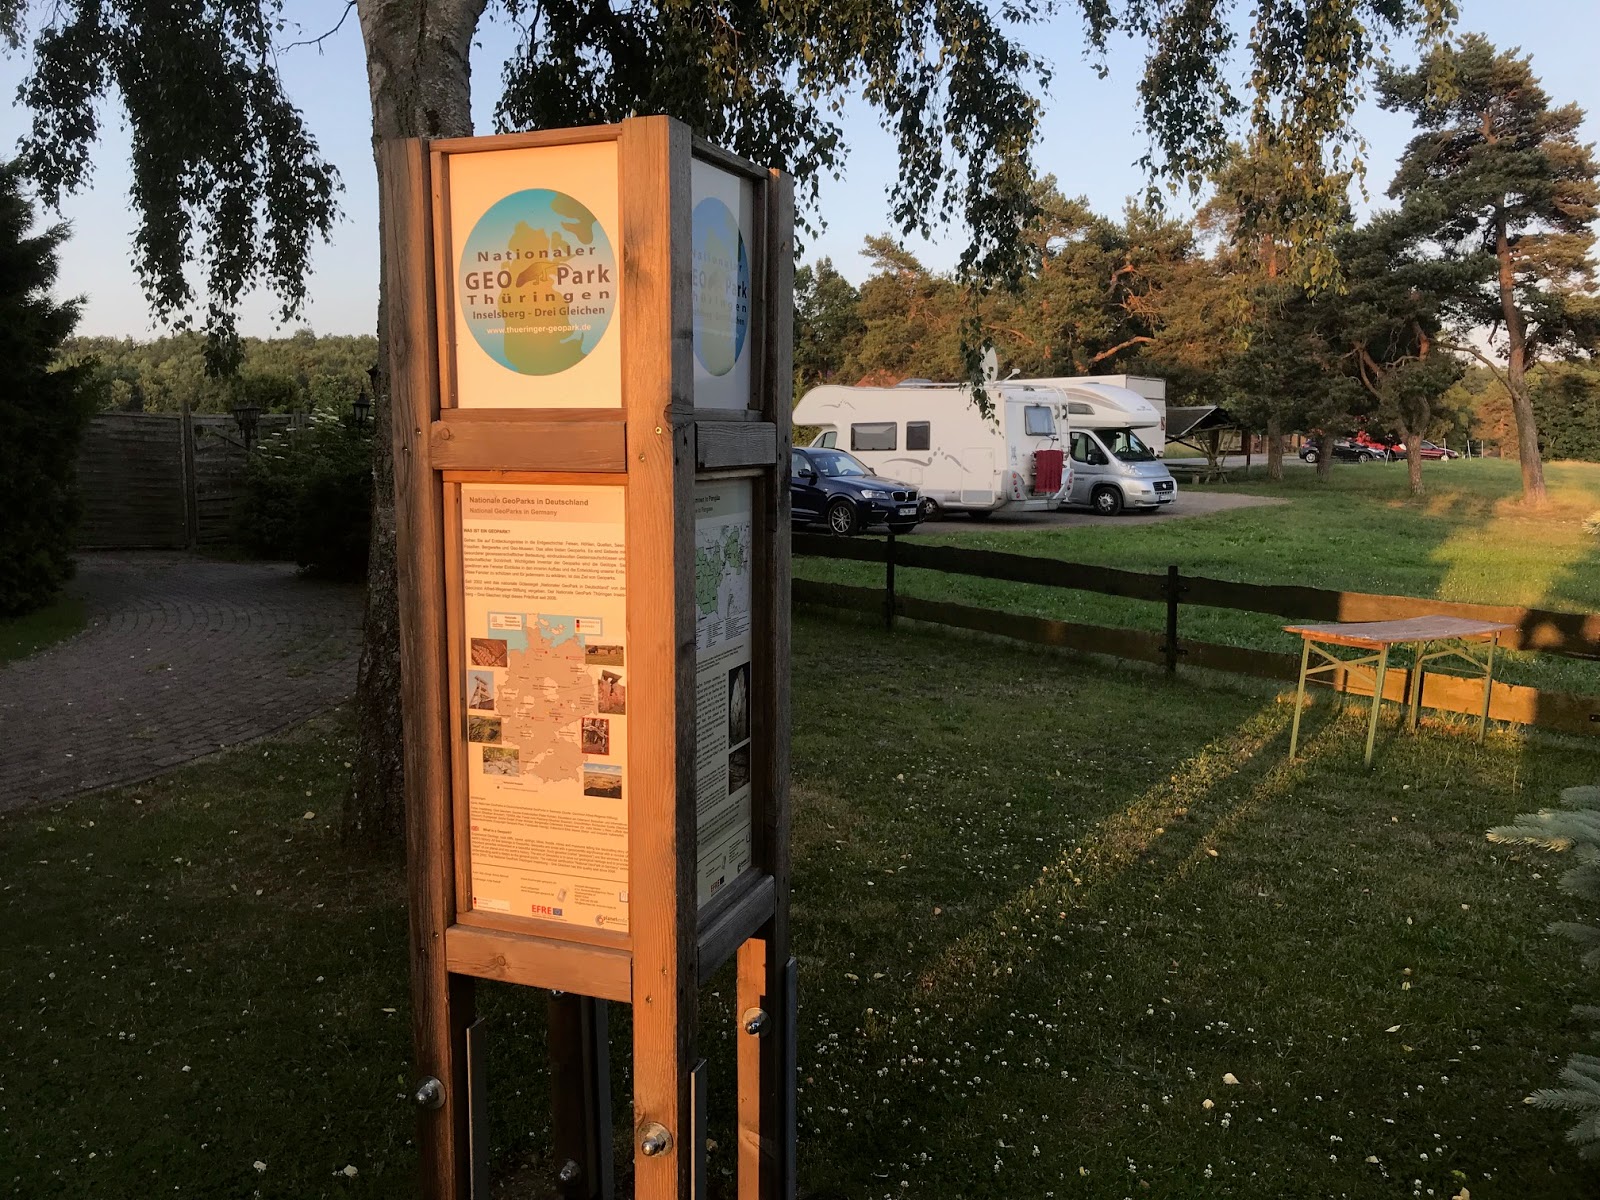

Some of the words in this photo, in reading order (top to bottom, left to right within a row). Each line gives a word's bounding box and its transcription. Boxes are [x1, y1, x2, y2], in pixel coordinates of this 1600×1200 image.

[477, 245, 596, 262] Nationaler
[466, 270, 512, 290] GEO
[557, 264, 611, 285] Park
[725, 277, 747, 299] Park
[467, 290, 610, 305] Thüringen
[473, 310, 525, 320] Inselsberg
[535, 307, 556, 317] Drei
[559, 306, 605, 316] Gleichen
[487, 324, 591, 335] www.thueringer-geopark.de
[469, 496, 501, 504] Nationale
[502, 497, 535, 505] GeoParks
[545, 498, 589, 506] Deutschland
[532, 905, 552, 914] EFRE
